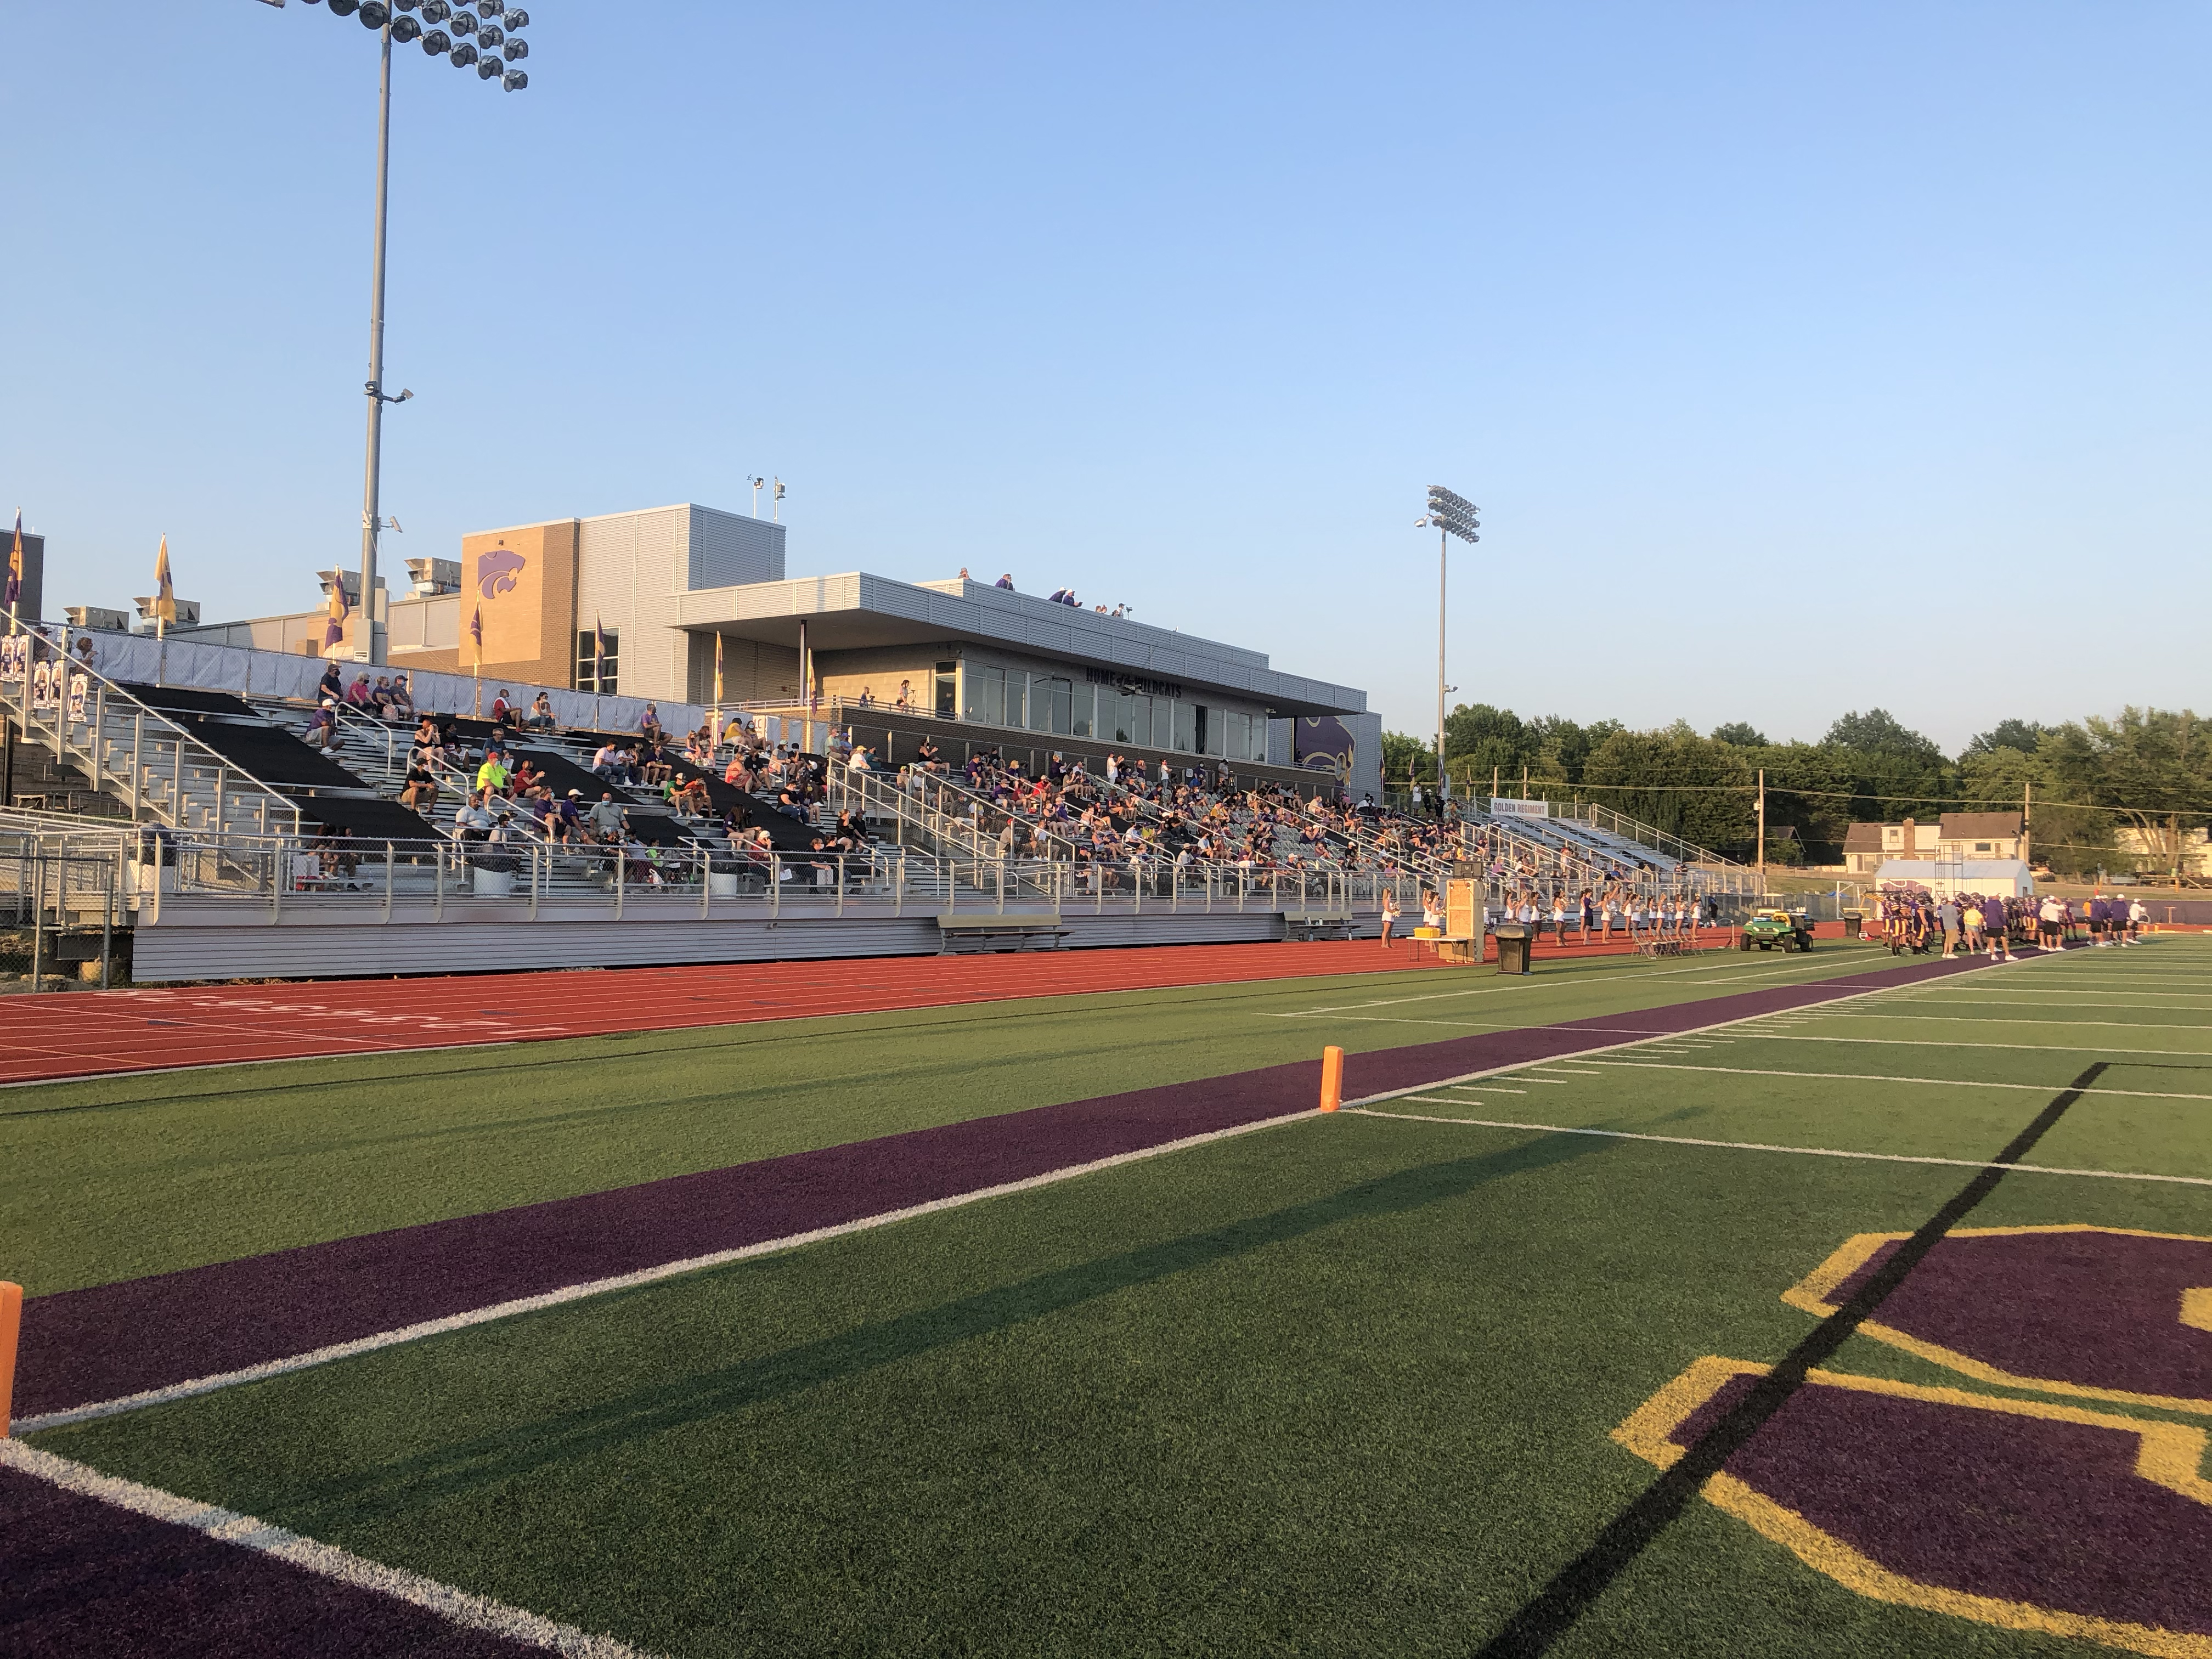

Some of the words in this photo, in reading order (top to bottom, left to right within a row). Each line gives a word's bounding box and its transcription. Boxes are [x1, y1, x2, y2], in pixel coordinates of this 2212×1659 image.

[1086, 667, 1115, 686] HOME
[1134, 675, 1182, 699] WILDCATS
[1494, 802, 1516, 812] GOLDEN
[1517, 804, 1545, 815] REGIMENT
